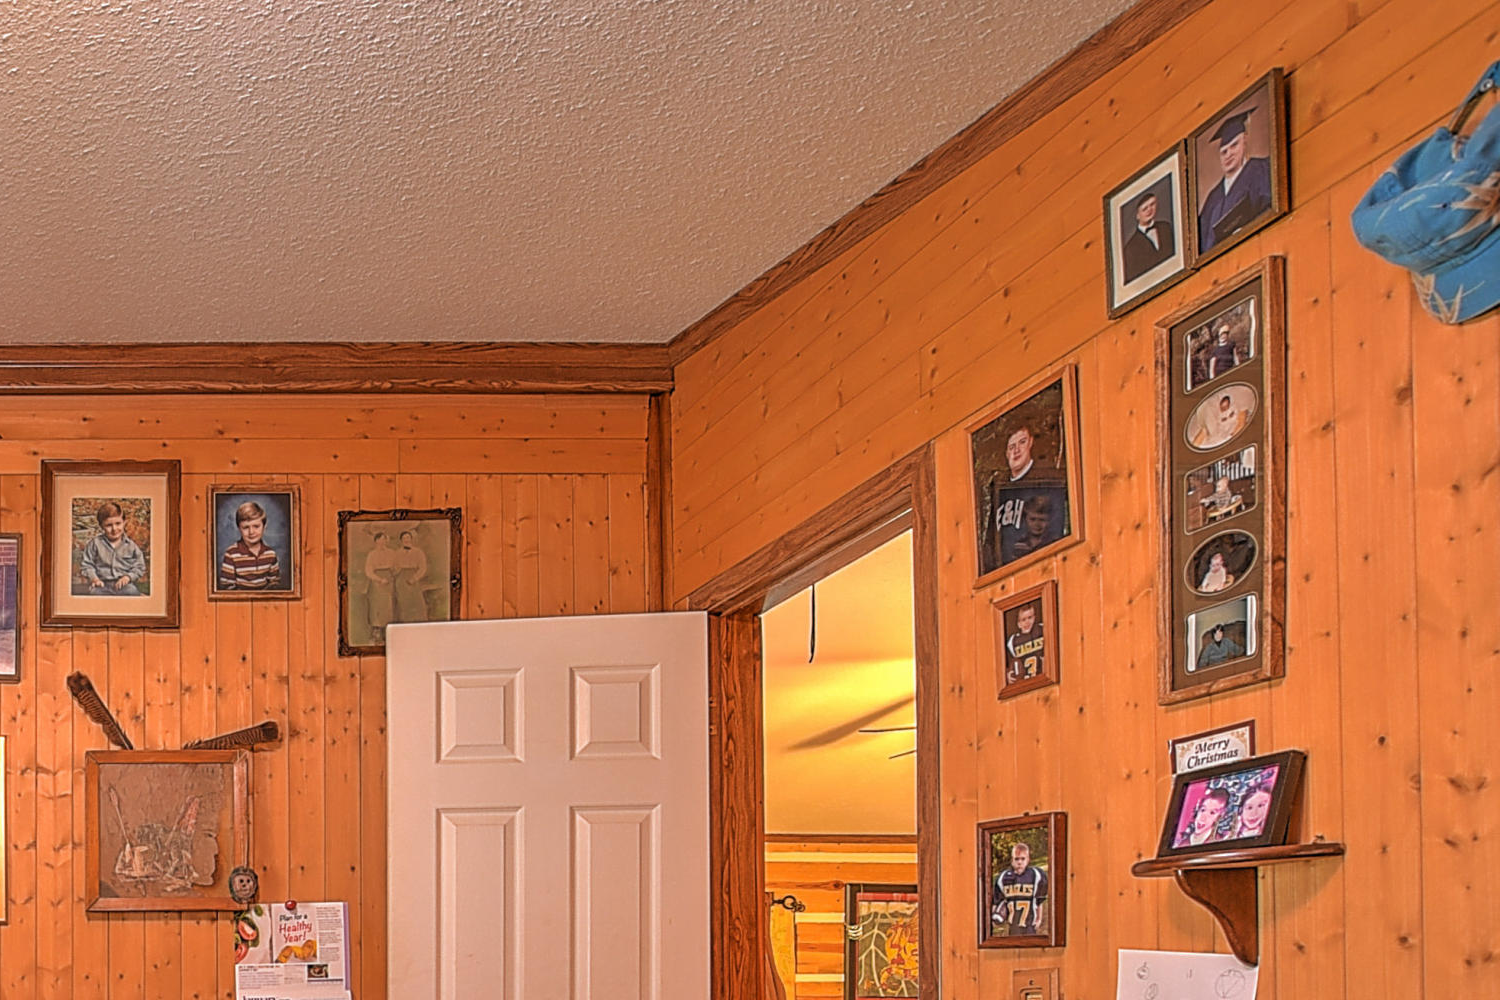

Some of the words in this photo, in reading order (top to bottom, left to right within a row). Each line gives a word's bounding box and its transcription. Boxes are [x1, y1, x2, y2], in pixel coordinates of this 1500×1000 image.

[996, 499, 1024, 531] E&H
[1194, 738, 1230, 754] Merry
[1187, 748, 1239, 770] Christmas
[1003, 884, 1034, 898] EAGLES
[279, 914, 293, 922] Plan
[1007, 900, 1031, 927] 17
[279, 921, 313, 933] Healthy
[283, 931, 307, 943] Year!
